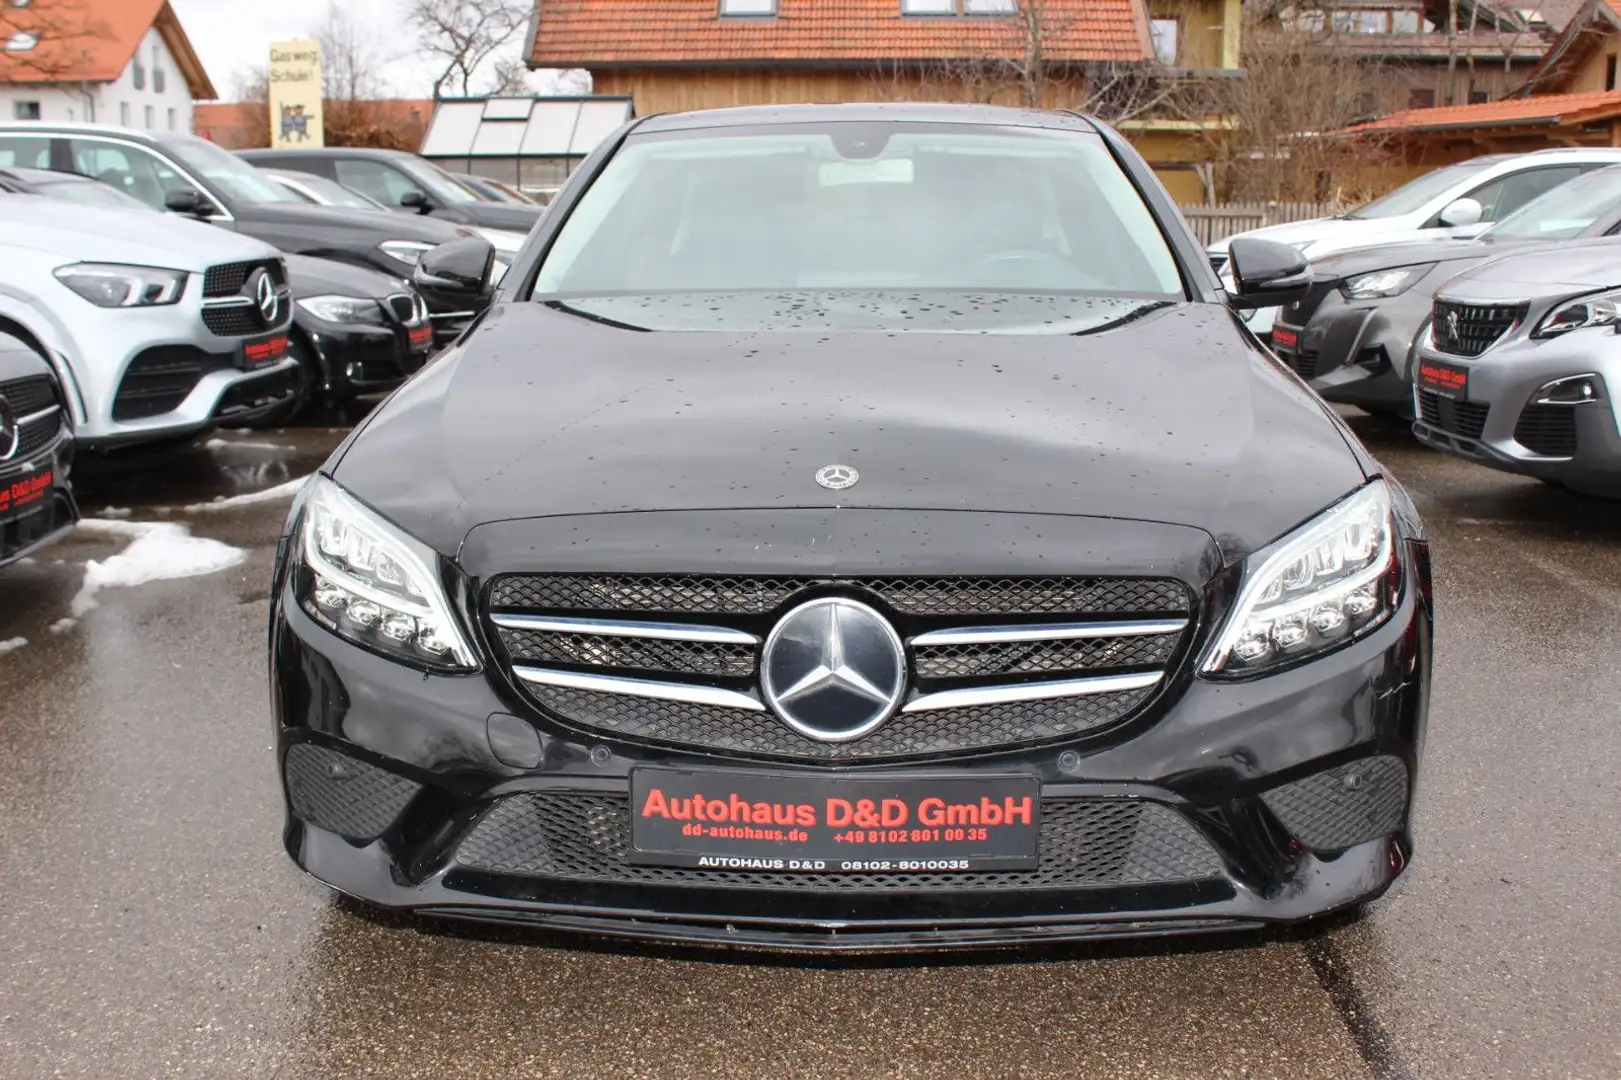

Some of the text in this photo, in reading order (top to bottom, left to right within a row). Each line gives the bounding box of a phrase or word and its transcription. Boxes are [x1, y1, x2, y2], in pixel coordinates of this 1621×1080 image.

[642, 788, 1032, 828] Autohaus D&D GmbH
[682, 823, 808, 842] dd-autohaus.de
[833, 828, 988, 844] +49 8102 801 00 35
[698, 856, 969, 870] AUTOHAUS D&D 08102-8010035
